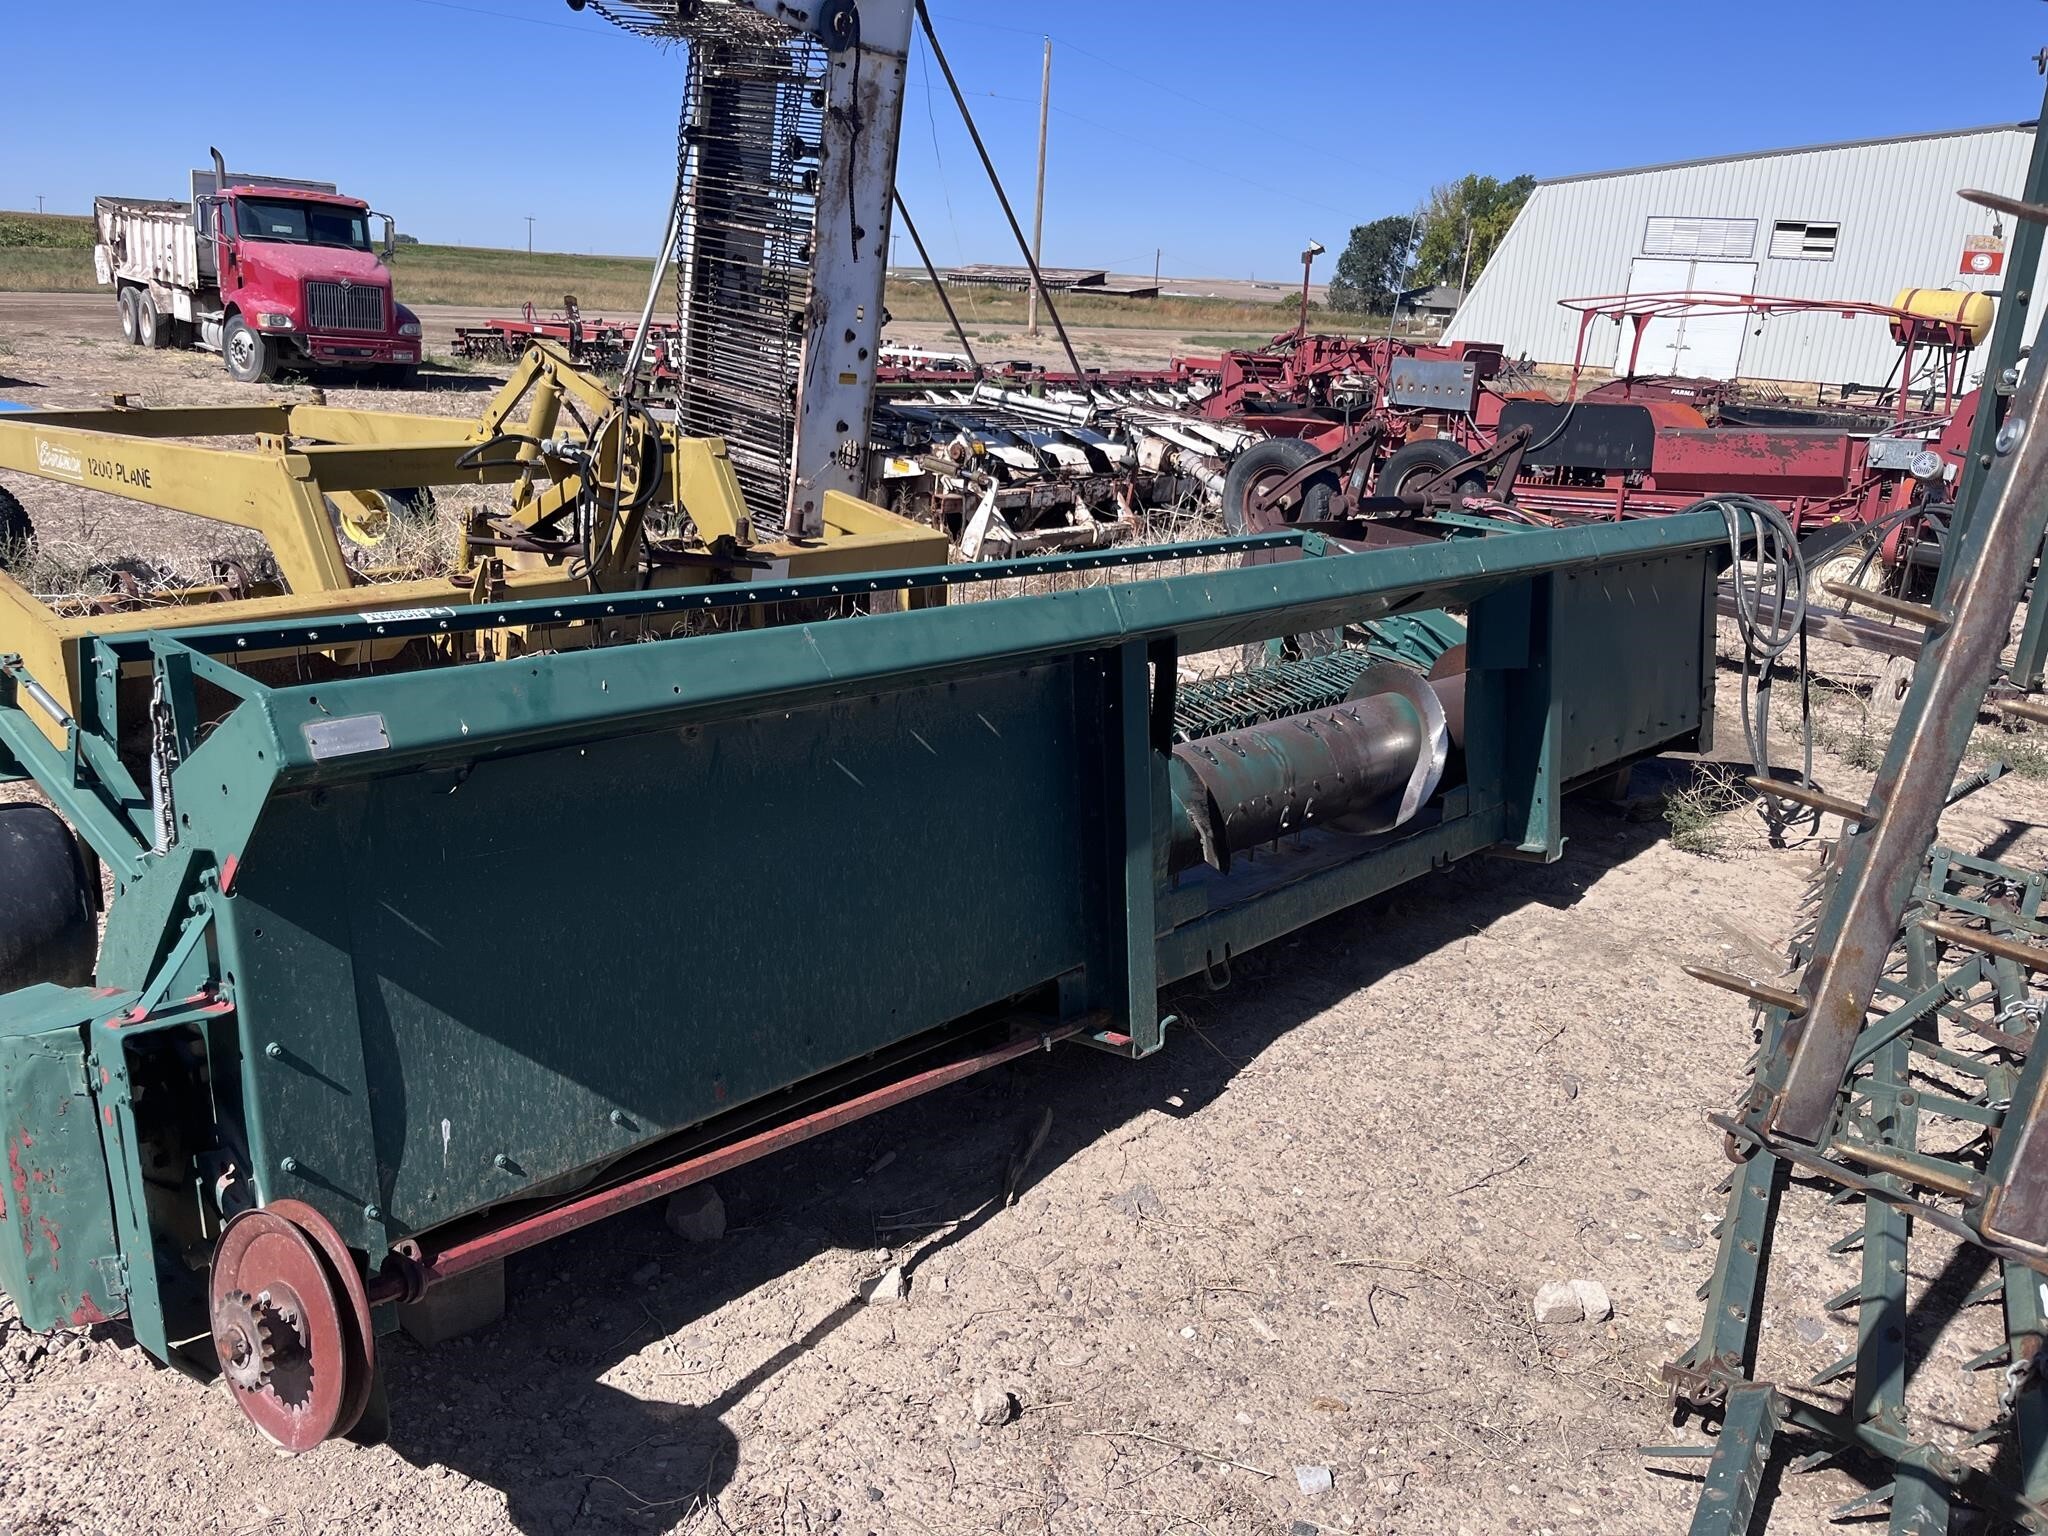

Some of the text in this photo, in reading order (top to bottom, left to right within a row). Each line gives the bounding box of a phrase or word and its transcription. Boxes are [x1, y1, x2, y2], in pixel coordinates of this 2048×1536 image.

[1671, 389, 1695, 397] PARMA
[87, 458, 152, 489] 1200 PLANE
